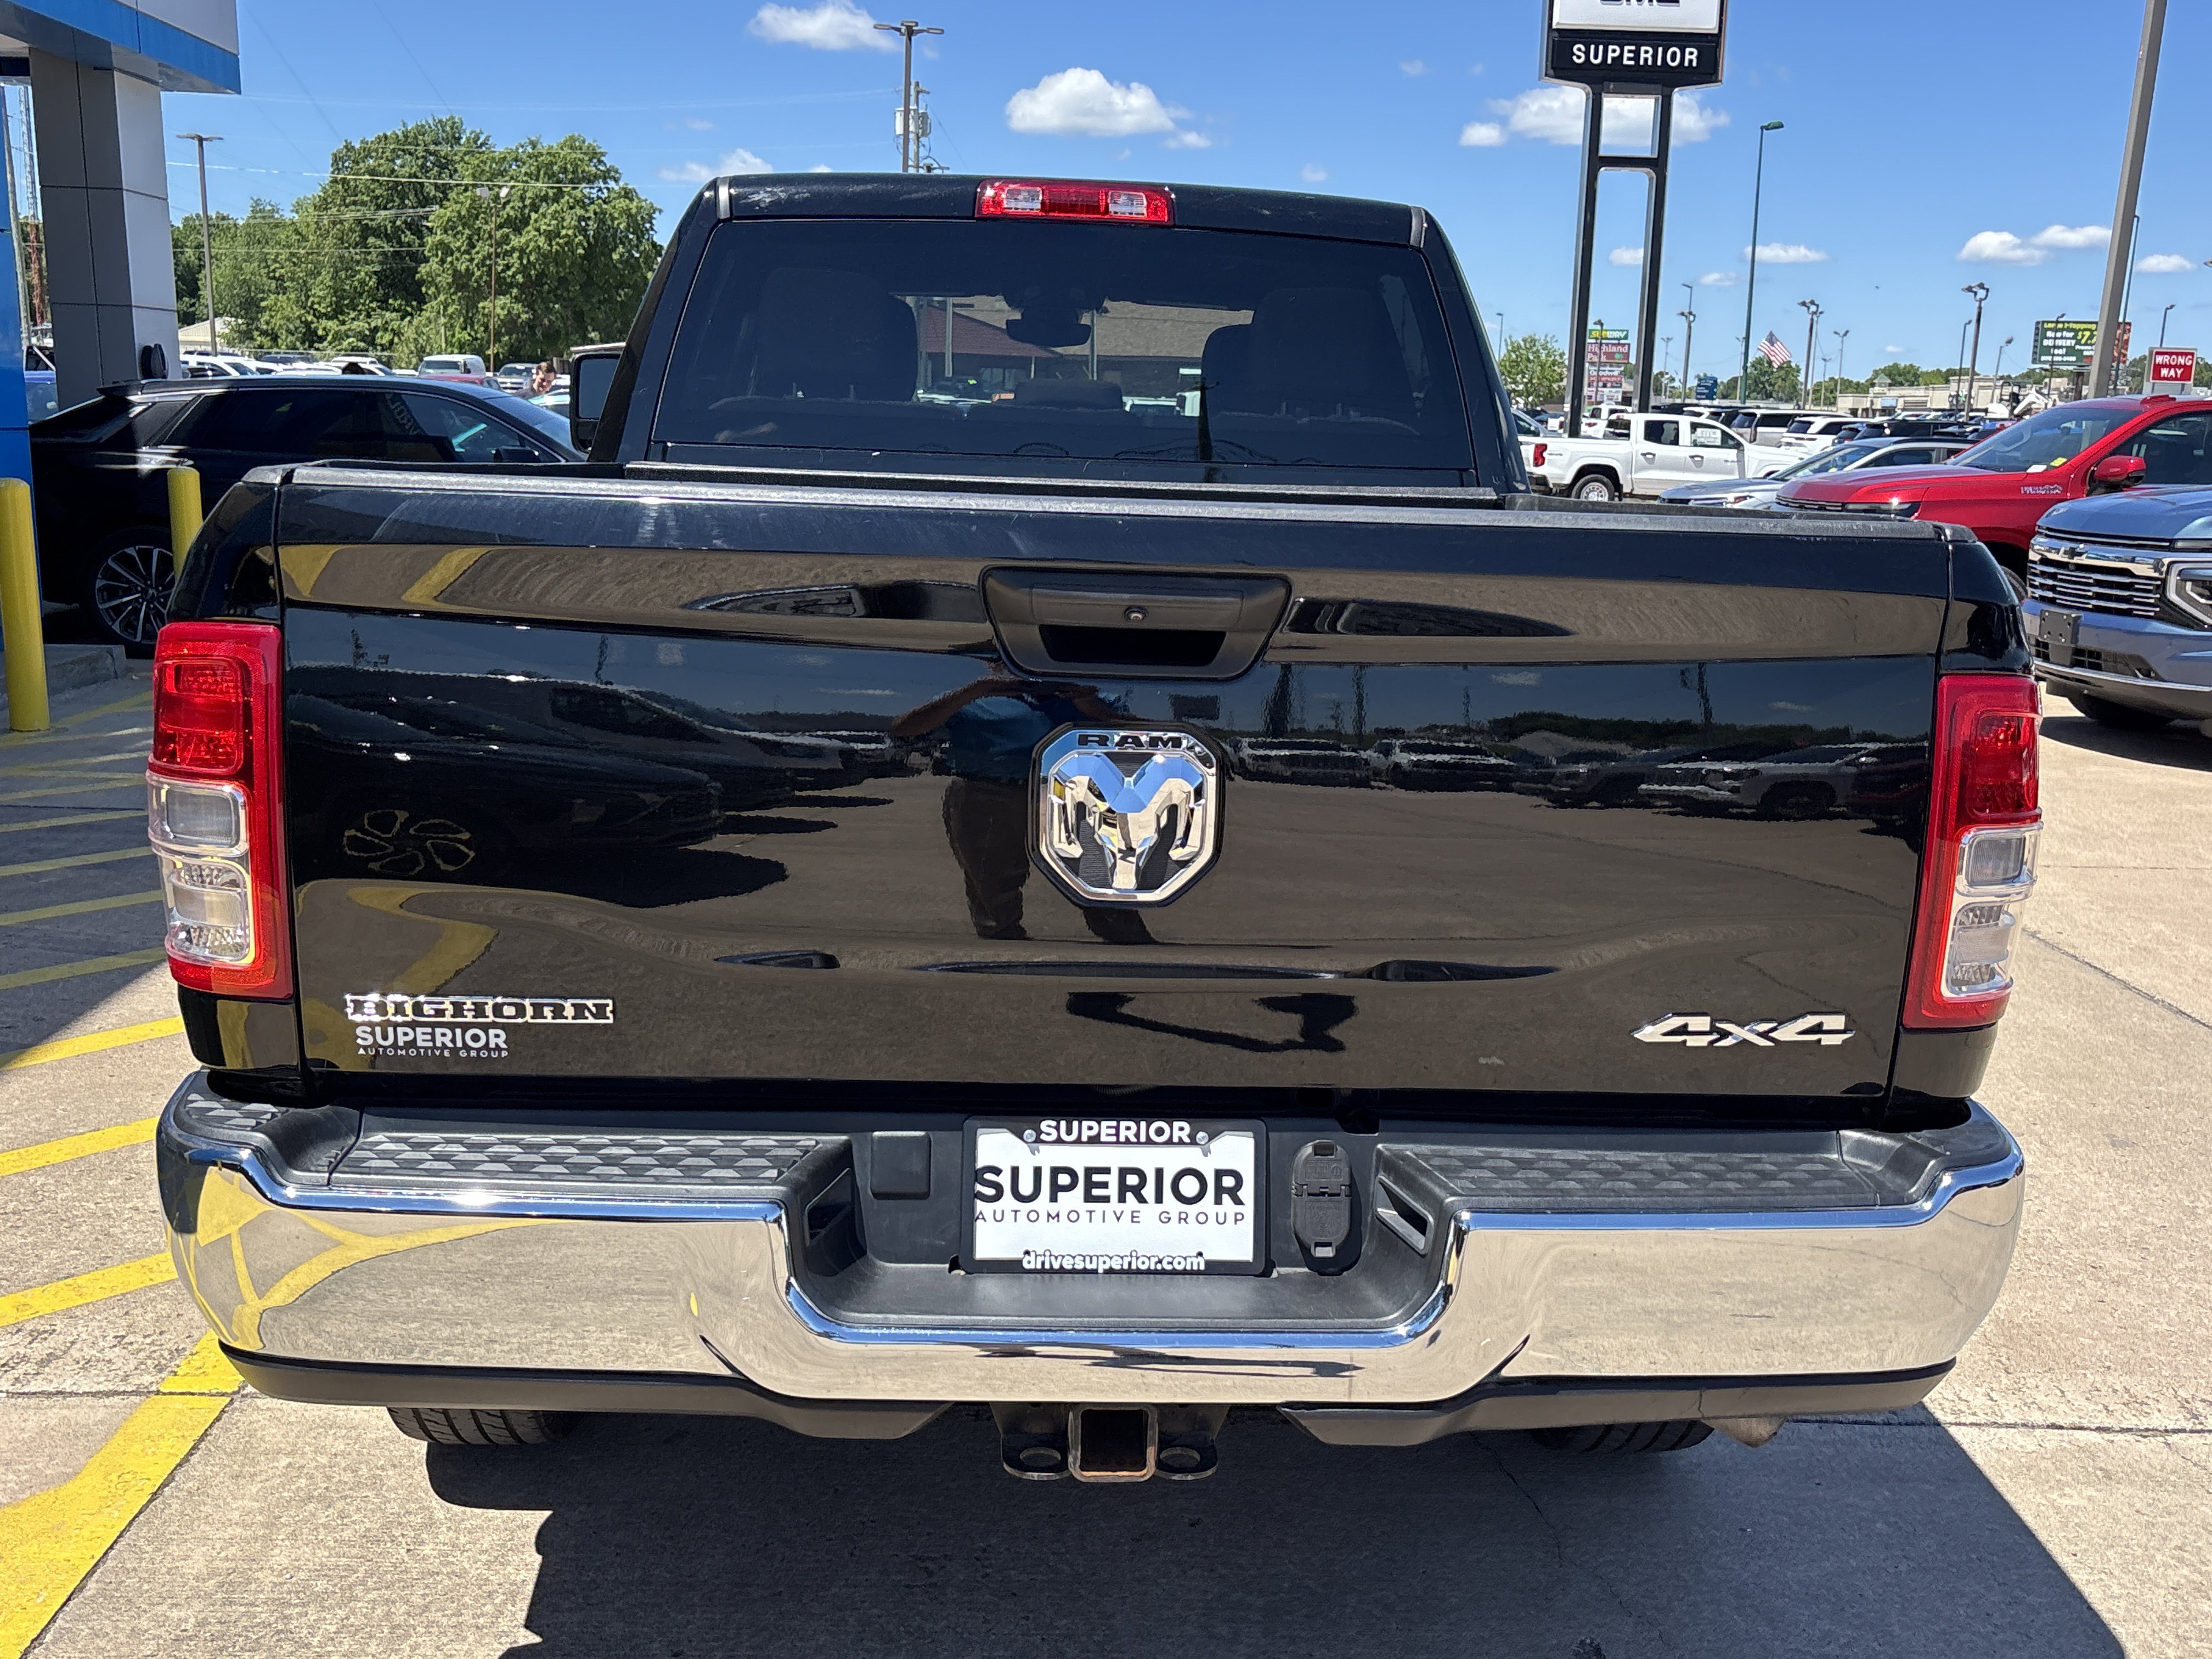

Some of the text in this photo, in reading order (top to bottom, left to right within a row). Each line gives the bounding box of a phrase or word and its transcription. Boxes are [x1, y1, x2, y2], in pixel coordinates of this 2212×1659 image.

[1572, 44, 1699, 67] SUPERIOR
[1587, 352, 1606, 360] Pak
[2155, 355, 2192, 366] WRONG
[2160, 368, 2183, 378] WAY
[1077, 733, 1182, 748] RAM
[345, 994, 614, 1024] BIGHORN
[356, 1026, 508, 1049] SUPERIOR
[358, 1047, 509, 1058] AUTOMOTIVE GROUP
[1040, 1120, 1191, 1143] SUPERIOR
[974, 1165, 1245, 1206] SUPERIOR
[974, 1209, 1245, 1226] AUTOMOTIVE GROUP
[1022, 1249, 1205, 1273] drivesuperior.com
